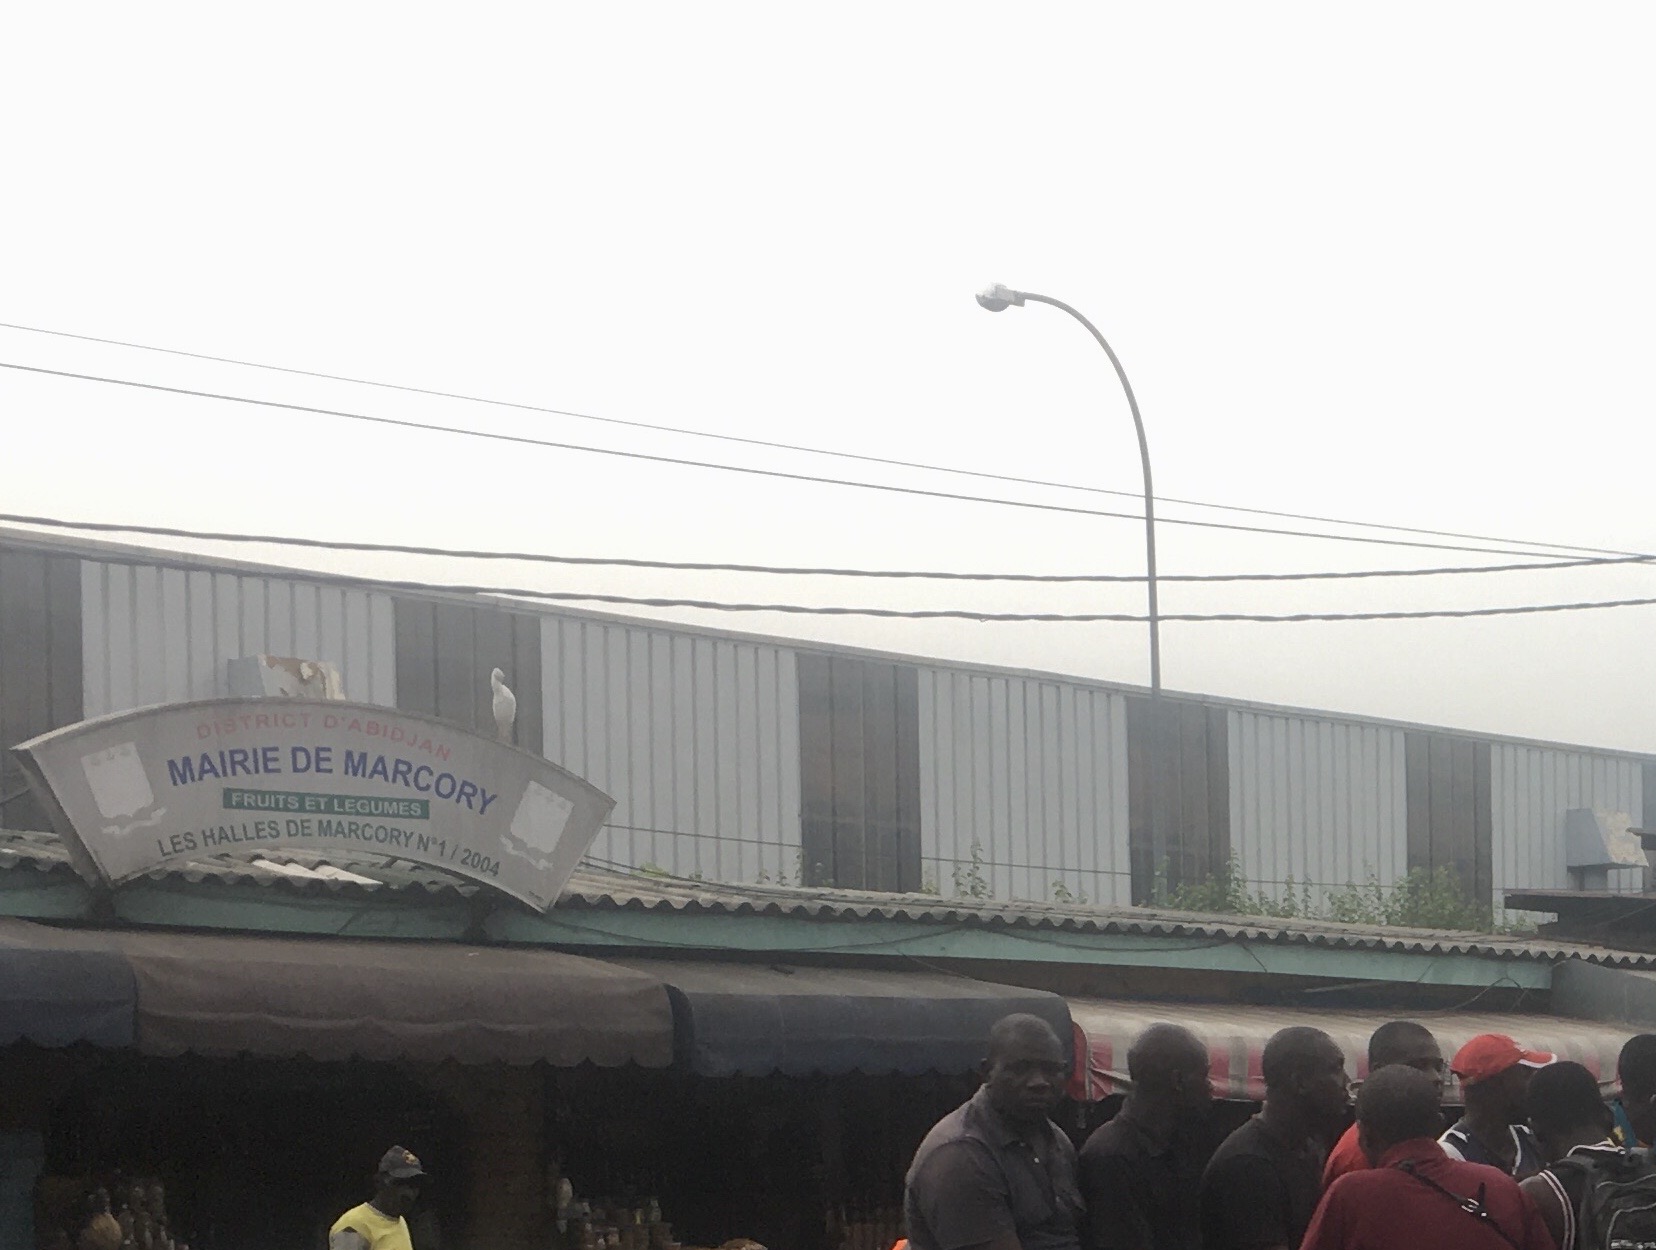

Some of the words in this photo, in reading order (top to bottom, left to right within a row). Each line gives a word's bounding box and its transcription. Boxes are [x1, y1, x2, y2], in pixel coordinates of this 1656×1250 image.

[197, 714, 311, 739] DISTRICT
[167, 746, 281, 786] MAIRIE
[291, 746, 333, 773] DE
[344, 750, 497, 815] MARCORY
[231, 792, 299, 809] FRUITS
[304, 797, 326, 811] ET
[334, 799, 421, 816] LEGUMES
[158, 832, 197, 857] LES
[202, 820, 280, 847] HALLES
[286, 819, 312, 838] DE
[318, 820, 414, 848] MARCORY
